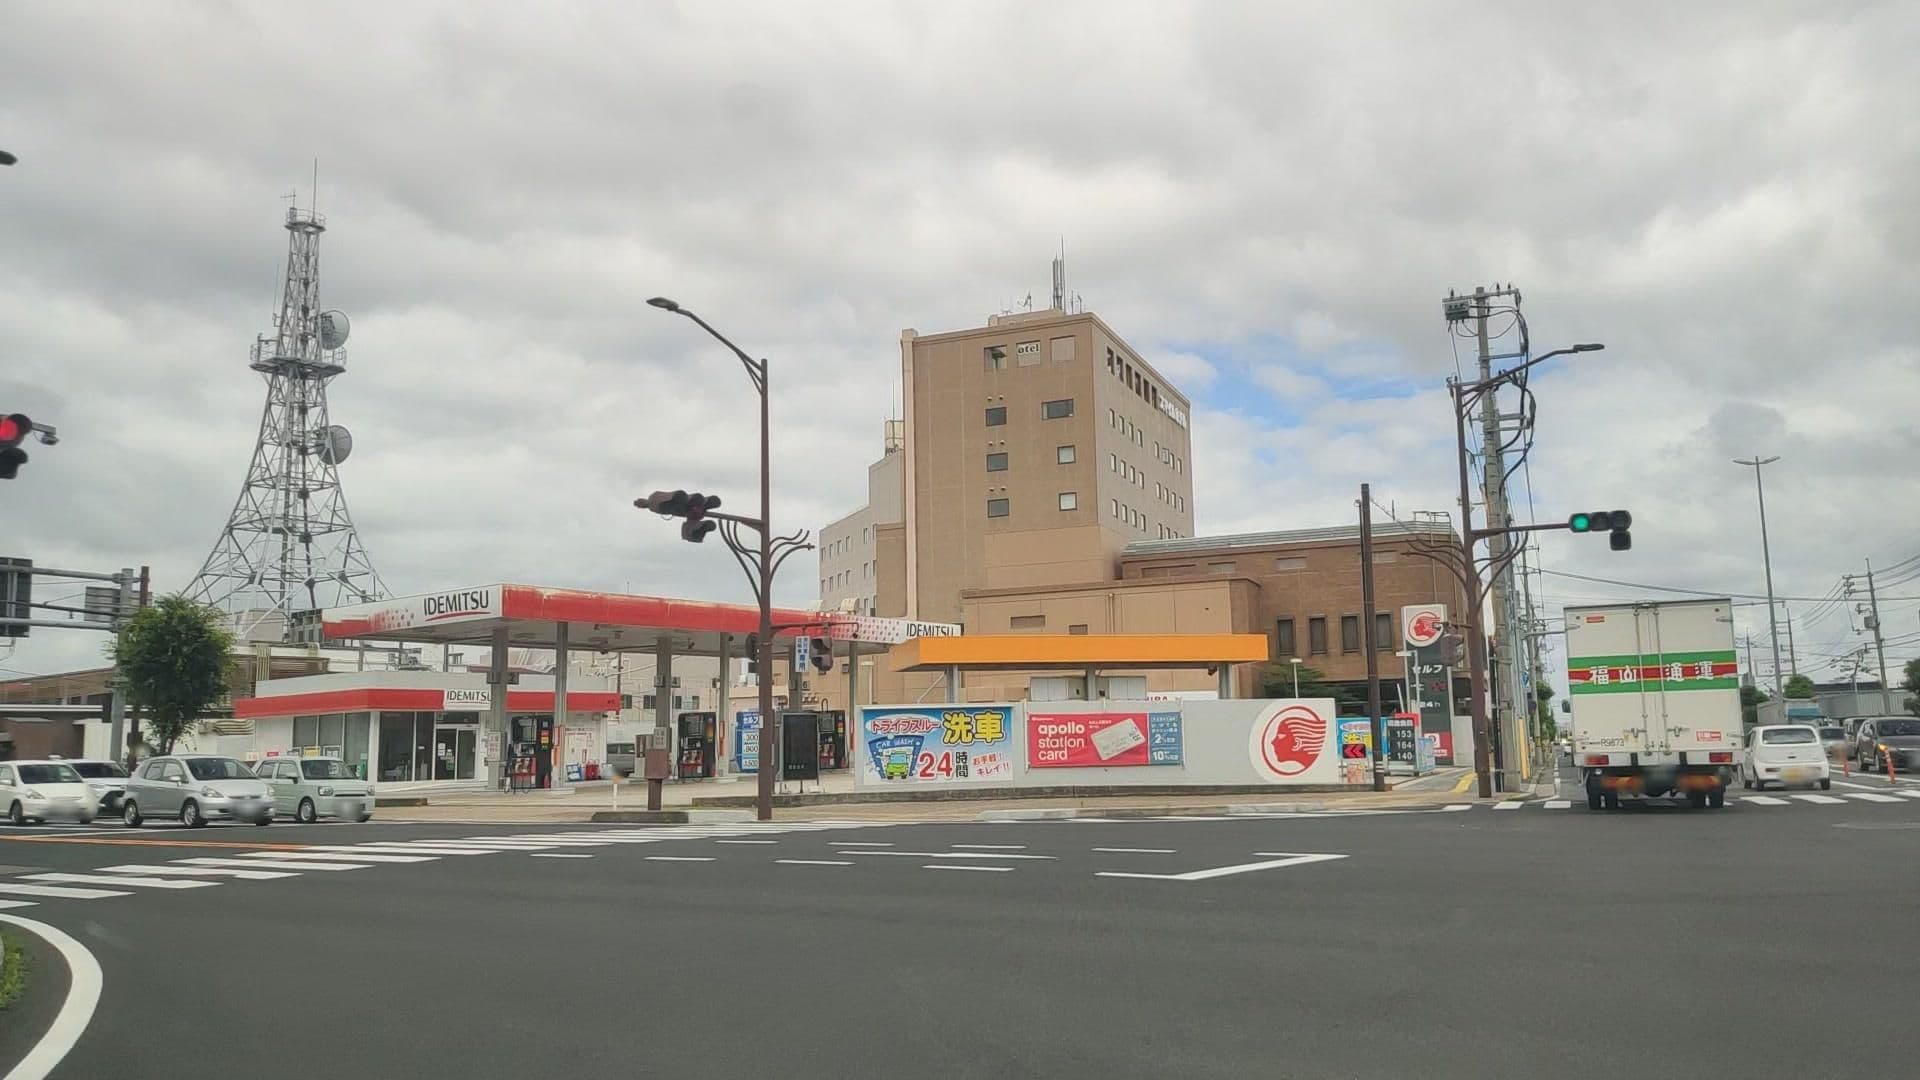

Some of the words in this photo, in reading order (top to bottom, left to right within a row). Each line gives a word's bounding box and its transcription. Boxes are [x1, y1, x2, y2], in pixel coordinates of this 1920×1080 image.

[423, 590, 490, 617] IDEMITSU
[1412, 664, 1443, 674] セルフ
[1589, 660, 1715, 686] 福山通運
[942, 710, 1004, 744] 洗車
[1038, 721, 1086, 739] apollo
[1396, 730, 1412, 738] 153
[1038, 735, 1085, 749] station
[1038, 748, 1068, 761] card
[1396, 751, 1413, 760] 140
